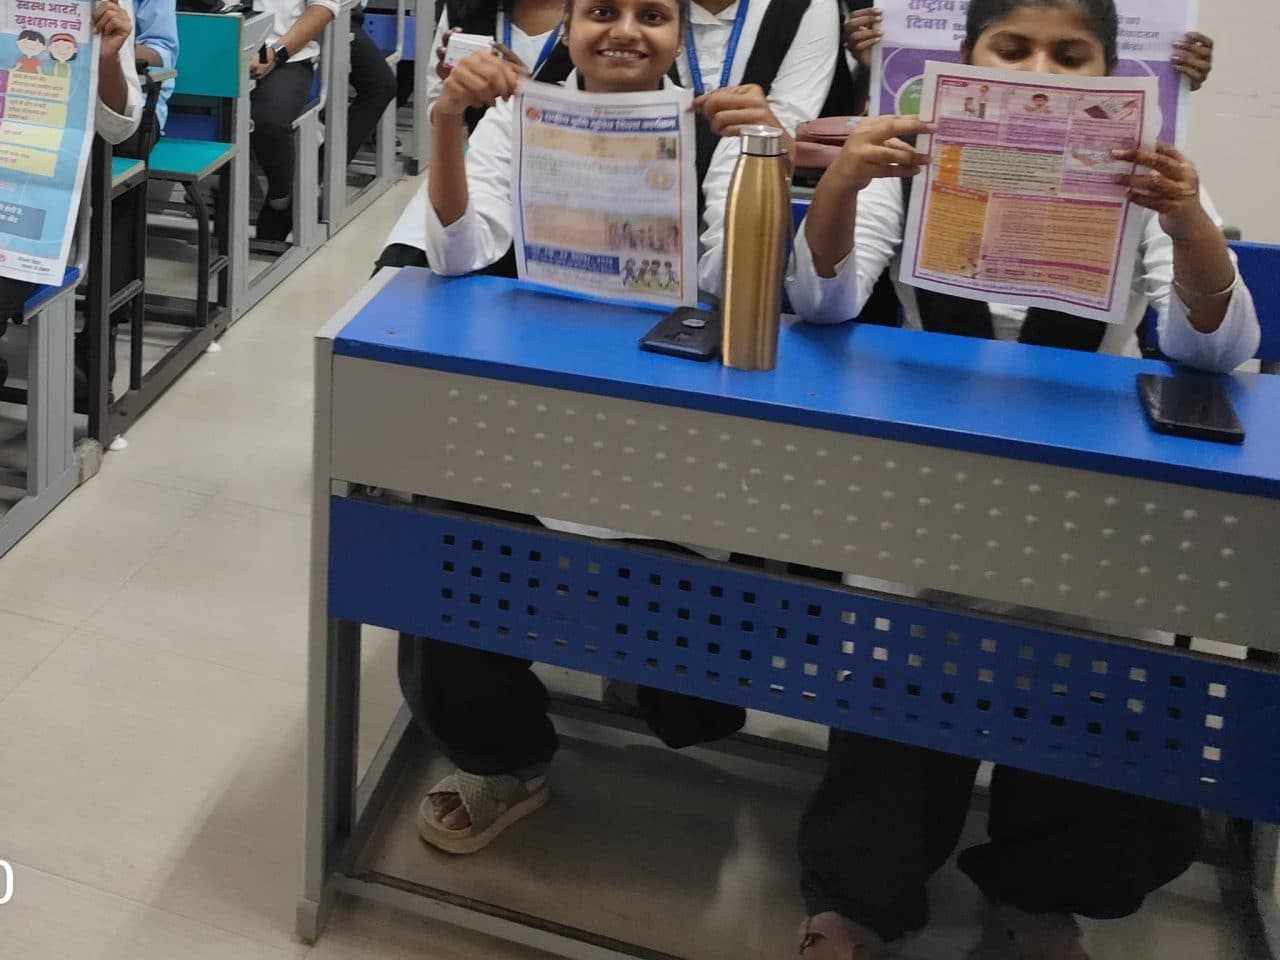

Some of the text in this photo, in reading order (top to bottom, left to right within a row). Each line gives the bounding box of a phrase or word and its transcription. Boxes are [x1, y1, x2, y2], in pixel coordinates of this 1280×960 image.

[16, 0, 81, 18] स्वस्थ आदतें,
[15, 14, 82, 32] खुशहाल बच्चे
[906, 14, 948, 30] दिवस
